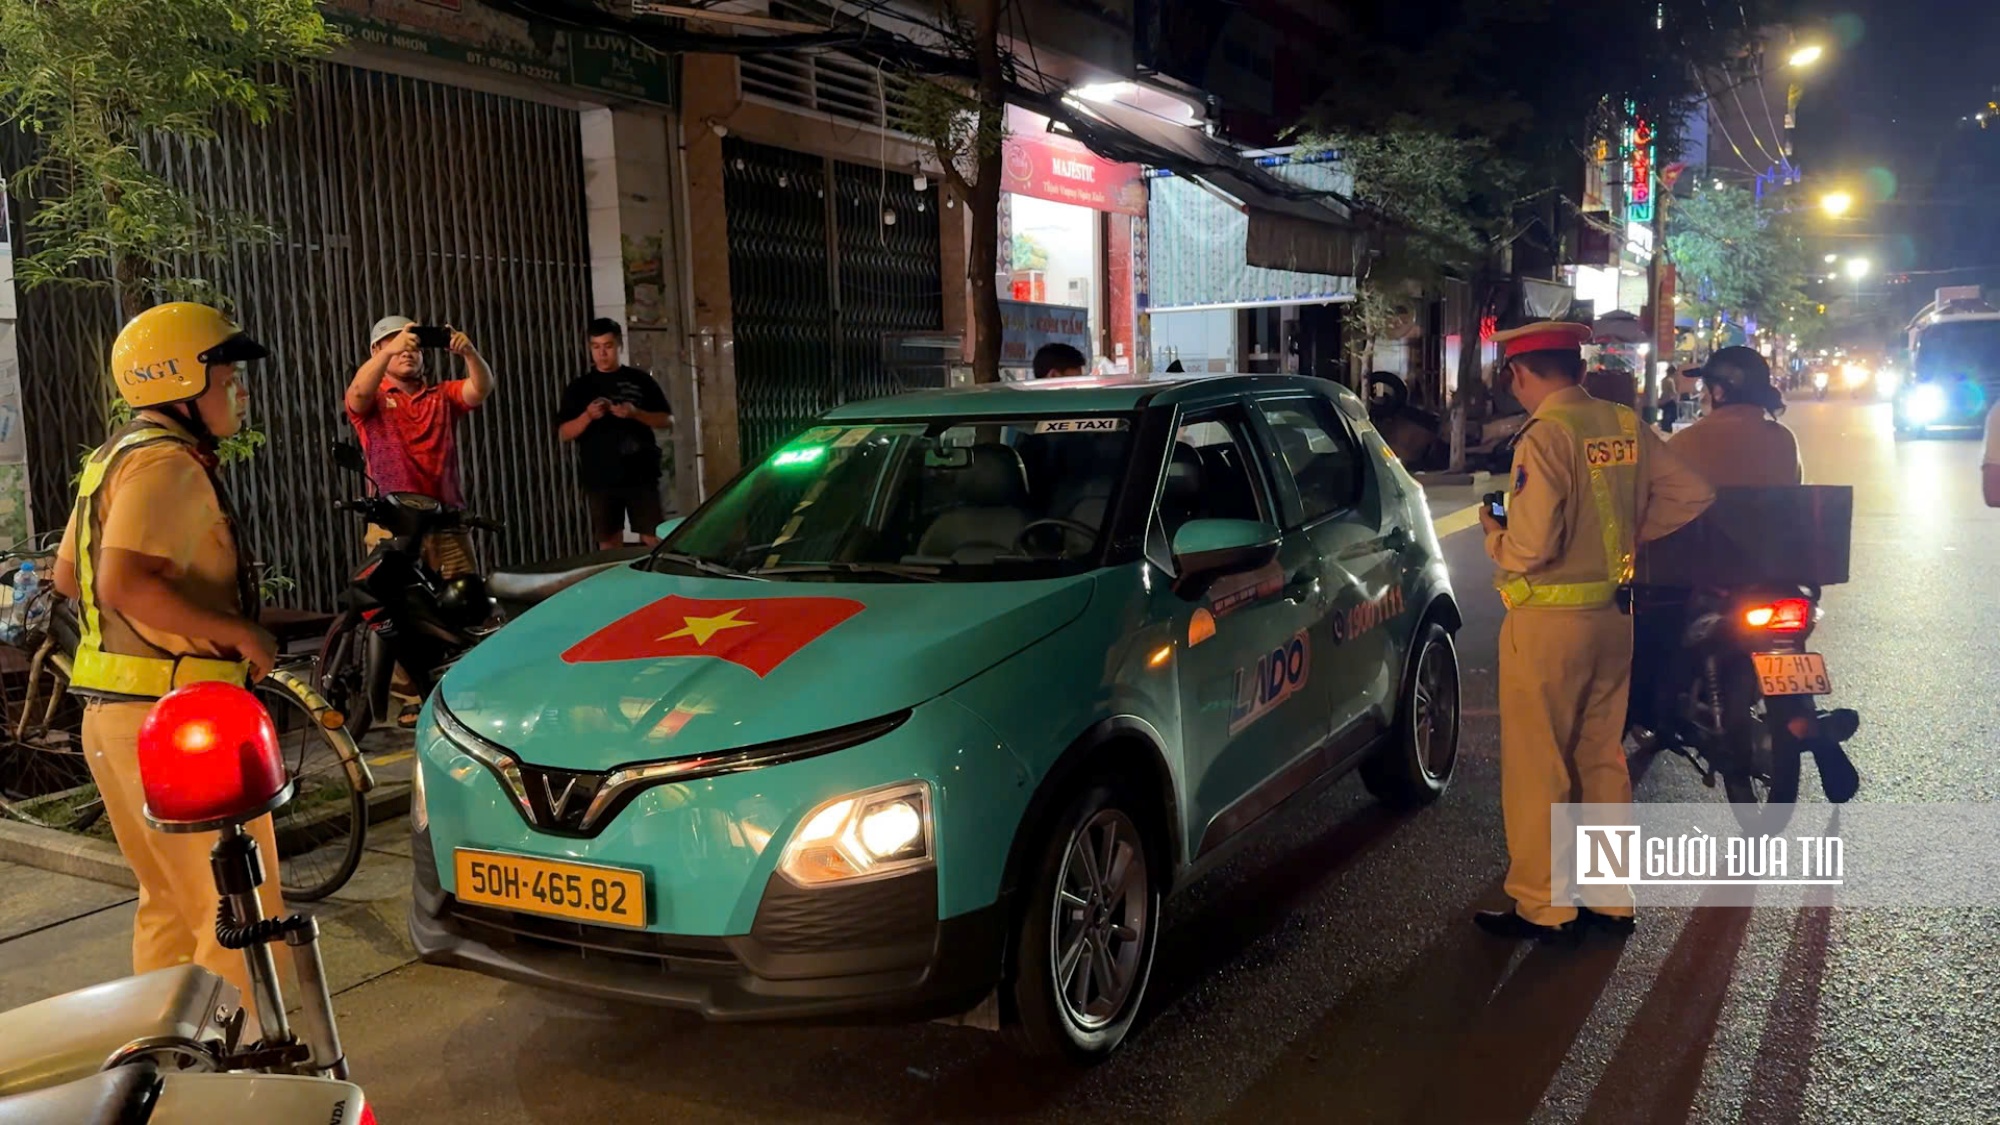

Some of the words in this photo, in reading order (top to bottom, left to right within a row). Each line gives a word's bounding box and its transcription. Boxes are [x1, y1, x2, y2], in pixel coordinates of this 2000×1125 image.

[362, 28, 388, 43] QUY
[123, 358, 179, 386] CSGT
[1045, 422, 1070, 431] XE
[1074, 420, 1114, 430] TAXI
[1586, 439, 1635, 464] CSGT
[1764, 656, 1814, 674] 77-H1
[1229, 634, 1306, 724] LADO
[1763, 674, 1827, 692] 555.49
[471, 861, 627, 915] 50H-465.82
